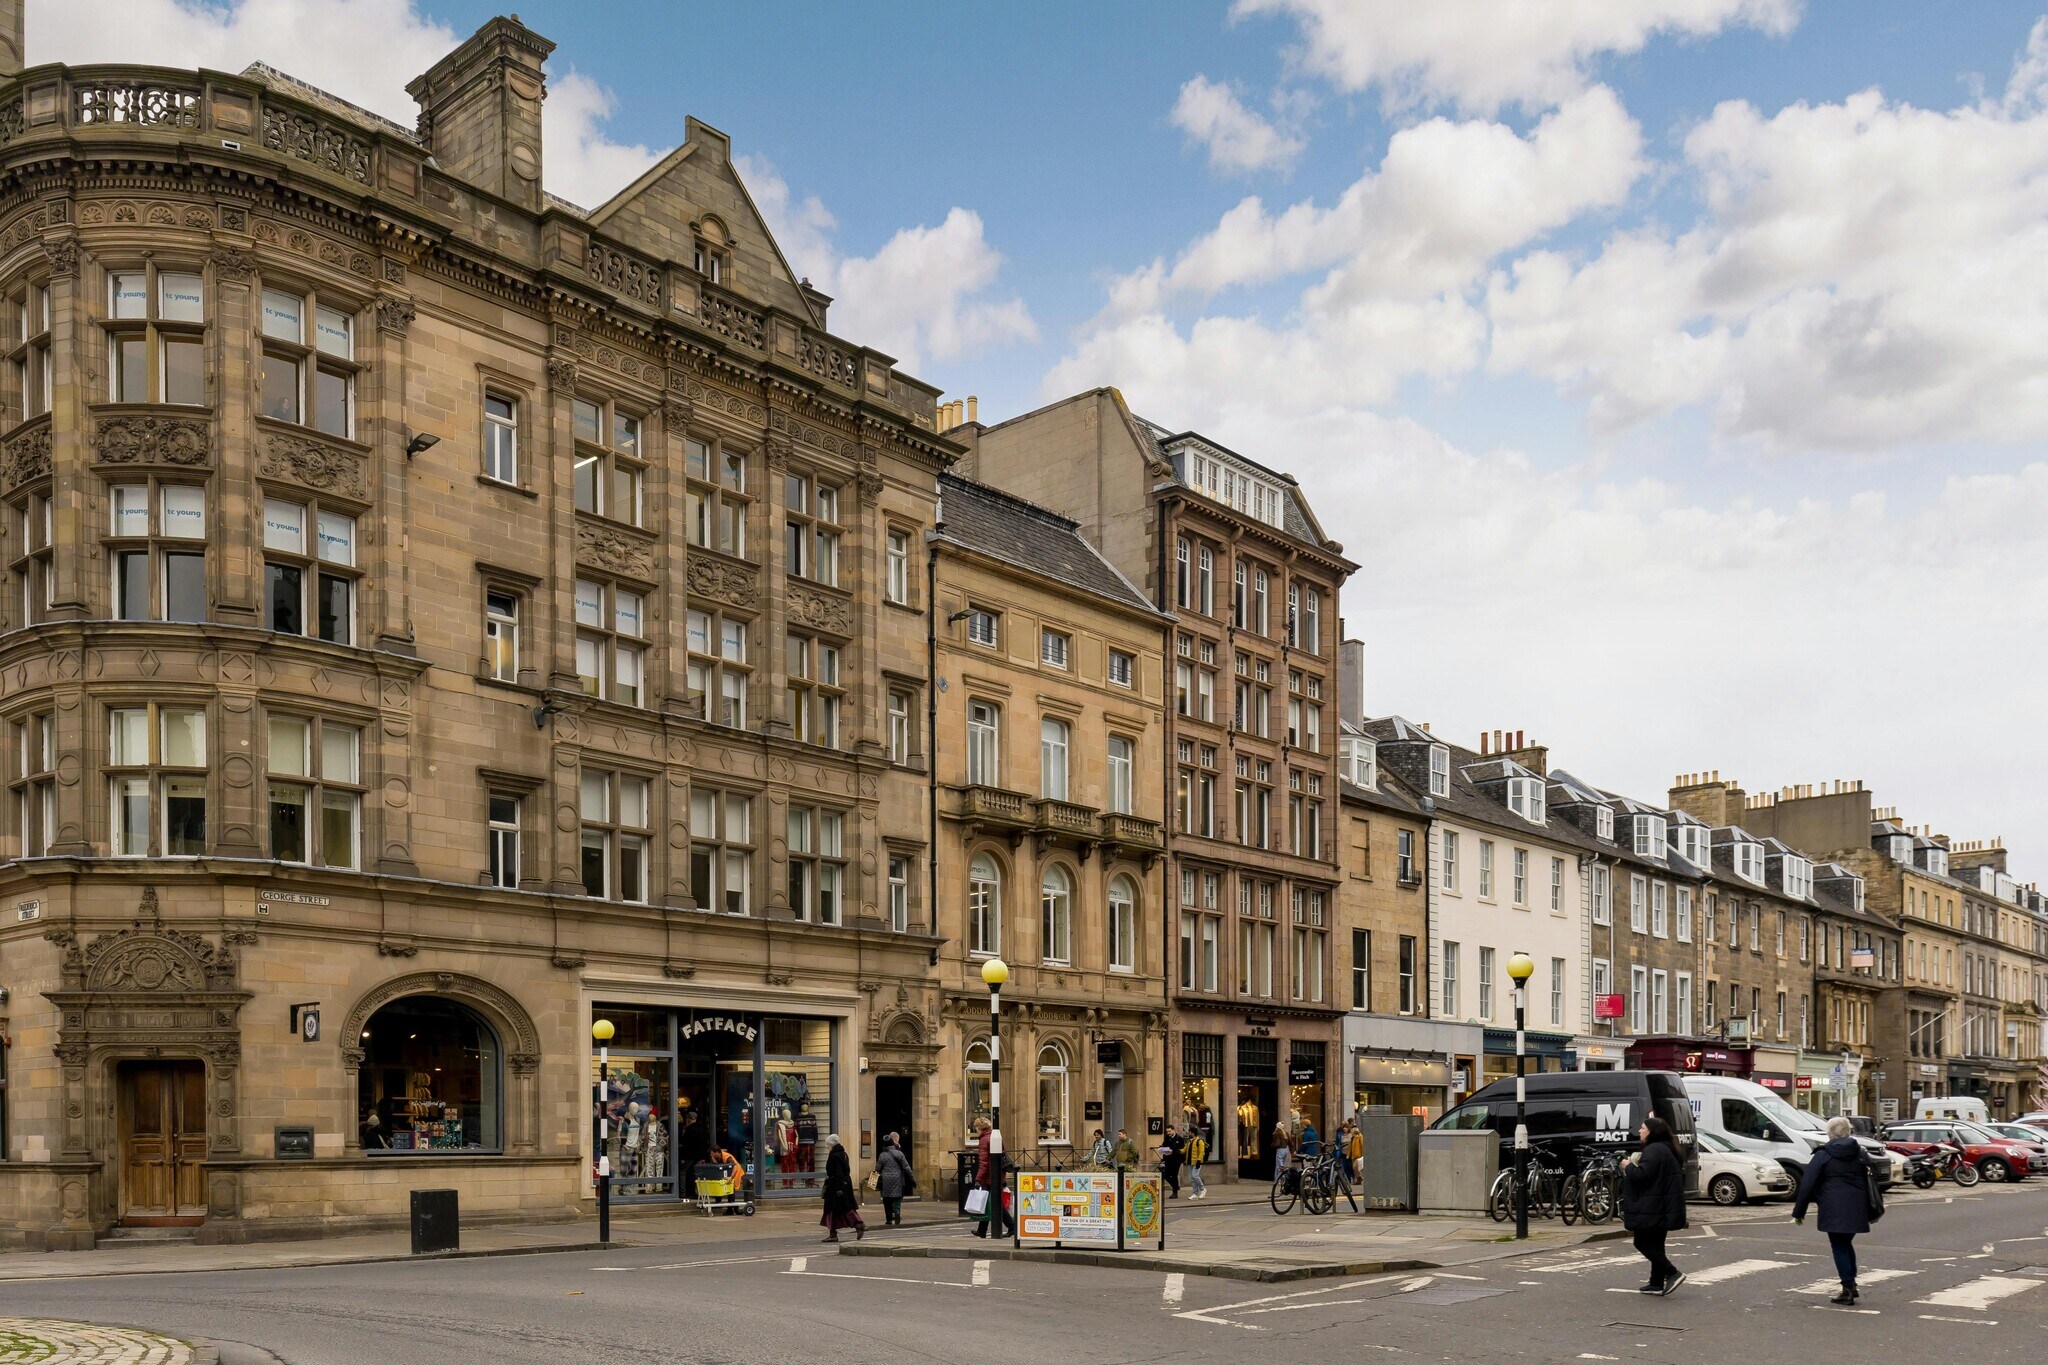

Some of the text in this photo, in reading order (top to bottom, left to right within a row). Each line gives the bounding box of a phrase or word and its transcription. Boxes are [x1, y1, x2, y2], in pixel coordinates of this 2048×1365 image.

[174, 293, 200, 302] young
[265, 307, 298, 322] tc young
[317, 323, 347, 340] tc young
[176, 510, 201, 518] young
[275, 522, 300, 534] young
[326, 534, 349, 547] young
[262, 891, 328, 905] GEORGE STREET
[681, 1017, 758, 1042] FATFACE
[1596, 1103, 1631, 1130] M
[1151, 1120, 1160, 1131] 67
[1595, 1131, 1630, 1142] PACT
